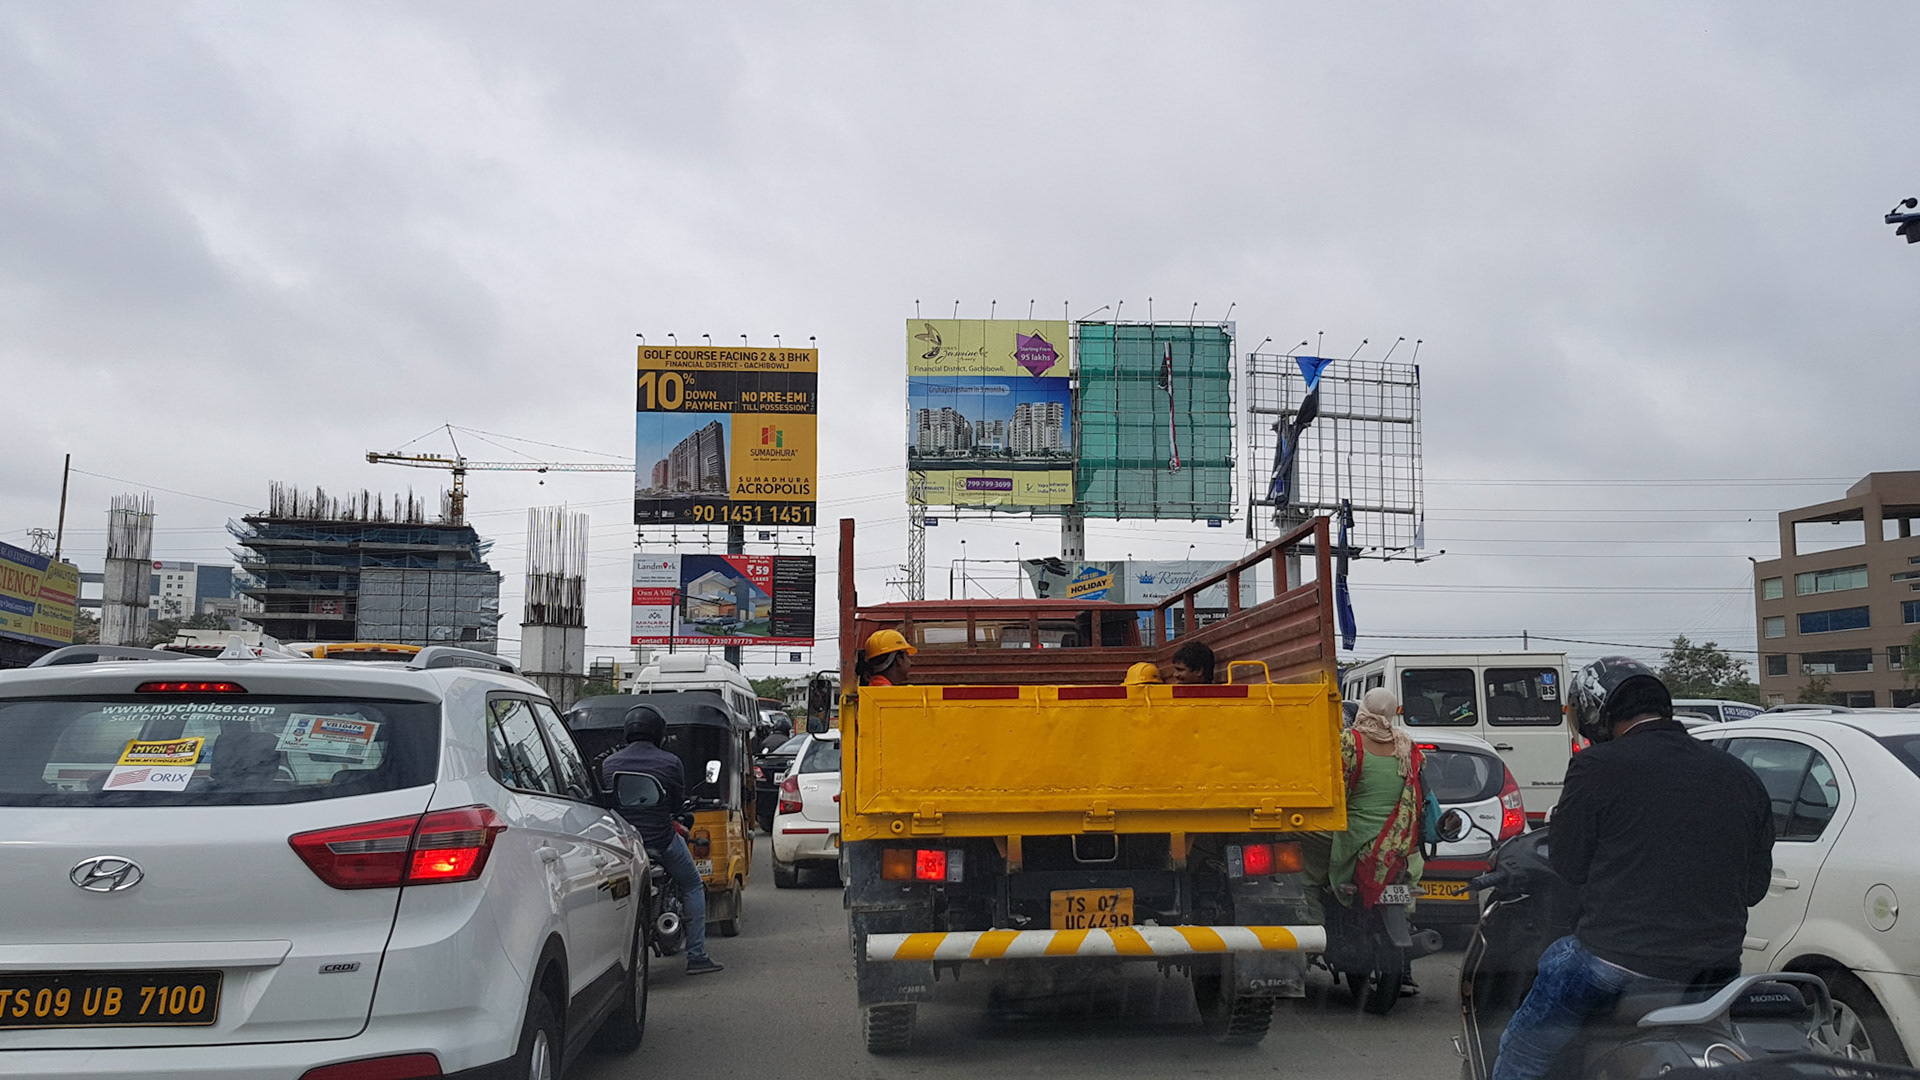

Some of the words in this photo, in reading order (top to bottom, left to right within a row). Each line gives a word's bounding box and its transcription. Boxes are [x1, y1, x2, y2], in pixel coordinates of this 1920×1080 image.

[644, 350, 672, 360] GOLF
[674, 350, 717, 361] COURSE
[720, 351, 758, 361] FACING
[761, 352, 767, 361] 2
[769, 352, 776, 361] &
[779, 352, 785, 361] 3
[788, 352, 809, 362] BHK
[638, 371, 695, 410] 10%
[686, 391, 716, 399] DOWN
[742, 392, 757, 402] NO
[760, 392, 806, 402] PRE-EMI
[736, 484, 810, 495] ACROPOLIS
[693, 505, 714, 522] 90
[721, 505, 761, 523] 1451
[770, 506, 810, 523] 1451
[756, 566, 769, 575] 59
[1070, 579, 1107, 594] HOLIDAY
[218, 609, 237, 617] IBM
[1542, 686, 1554, 695] BS
[102, 702, 276, 715] www.mychoize.com
[326, 722, 362, 730] VB10474
[151, 773, 187, 782] ORIX
[1066, 896, 1085, 912] TS
[1098, 895, 1118, 912] 07
[1382, 894, 1410, 903] A3805
[0, 988, 71, 1018] TS09
[82, 987, 124, 1016] UB
[139, 985, 206, 1015] 7100
